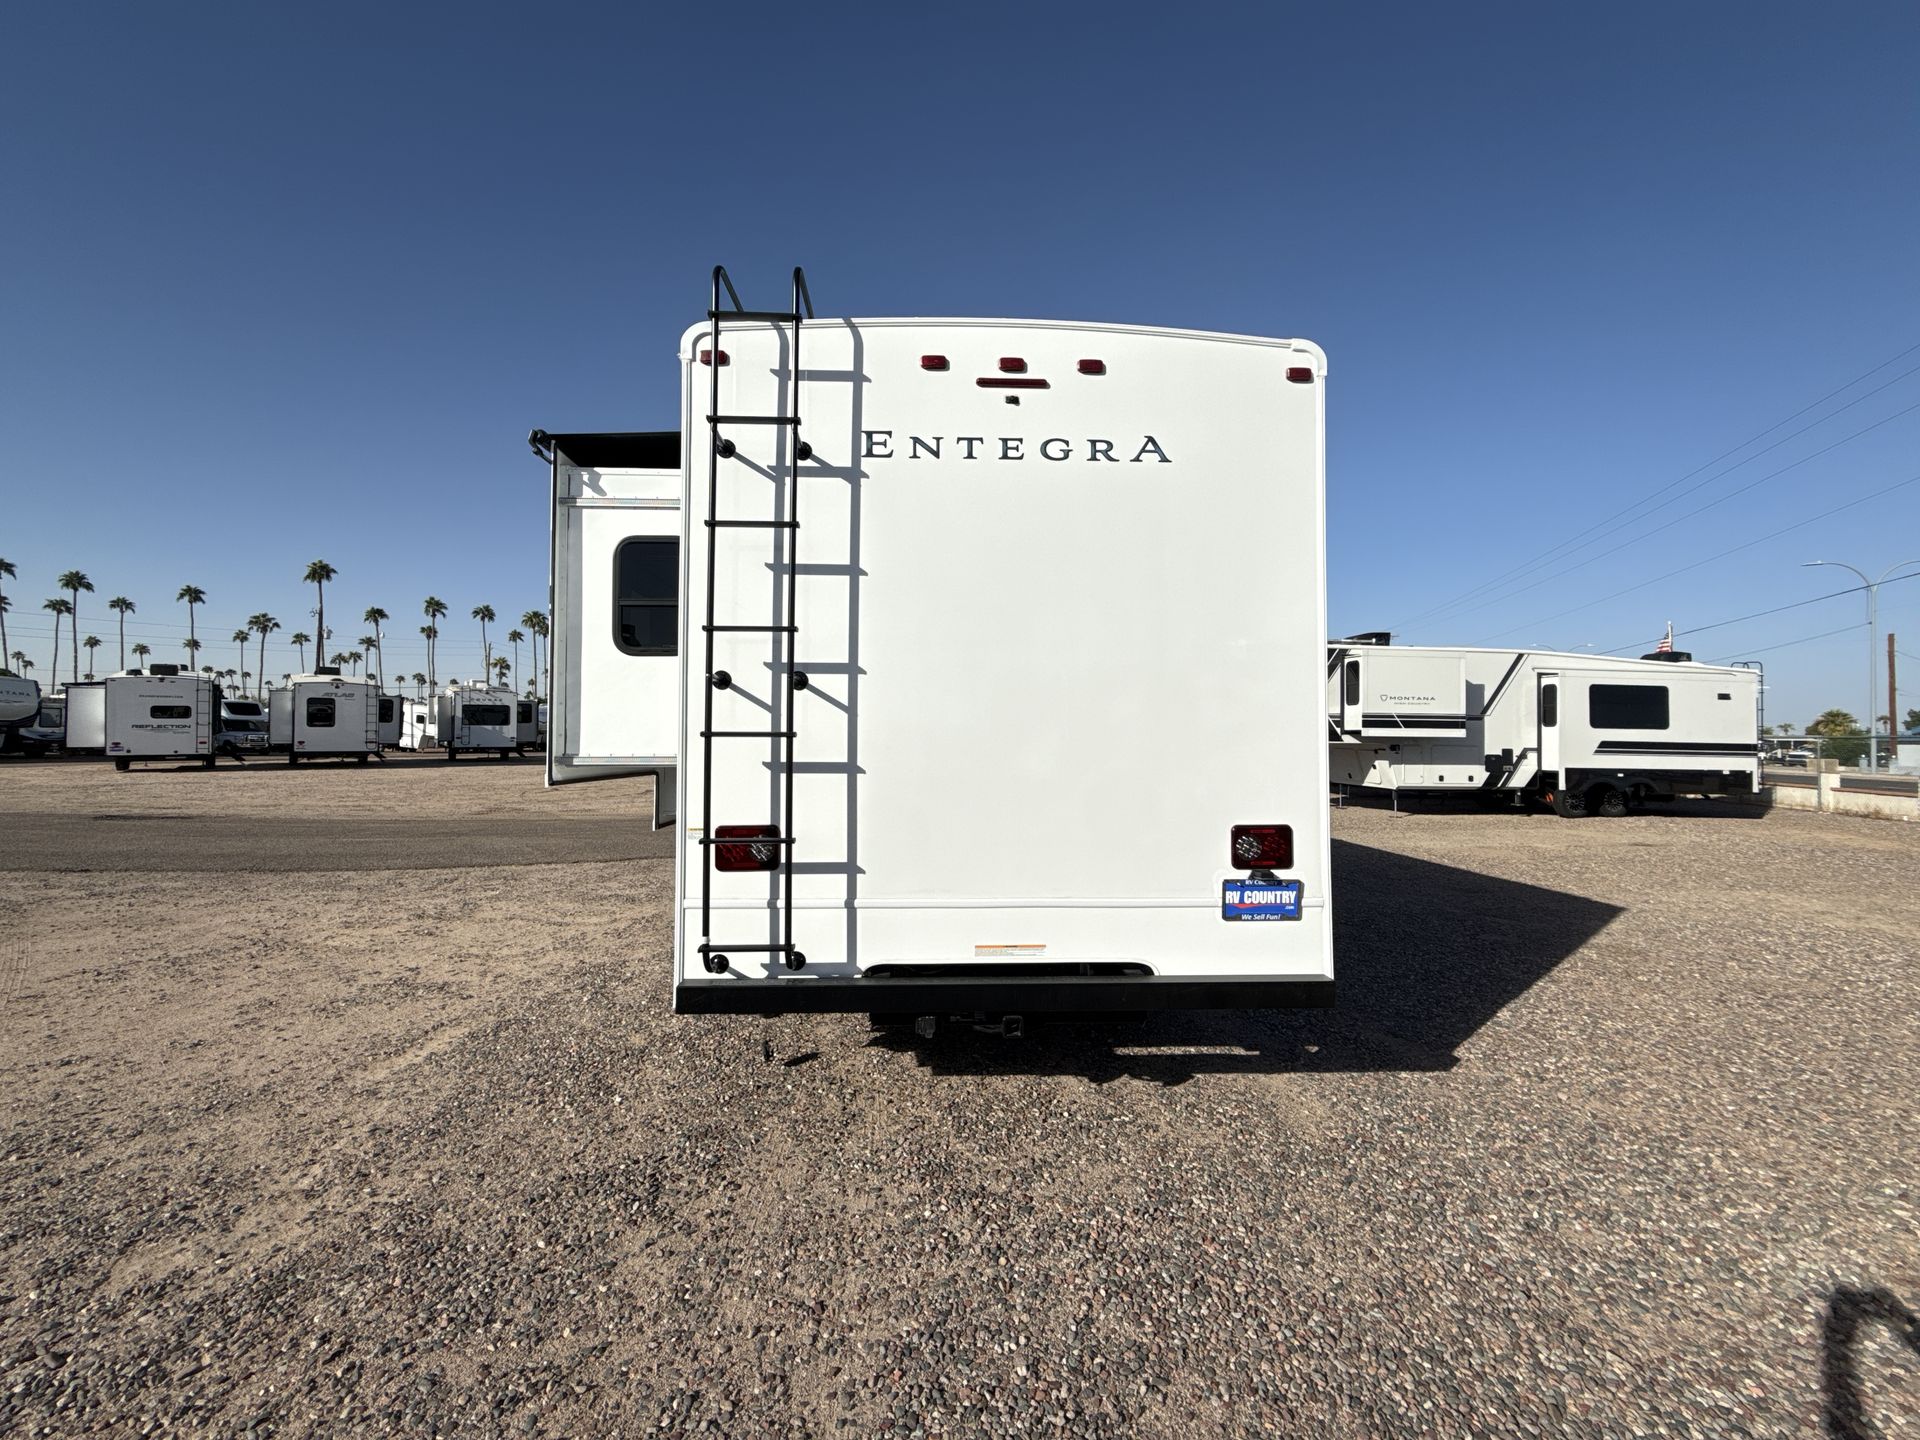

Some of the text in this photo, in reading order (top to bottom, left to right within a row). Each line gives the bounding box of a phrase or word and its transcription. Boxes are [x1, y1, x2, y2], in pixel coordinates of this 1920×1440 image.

[861, 430, 1173, 463] ENTEGRA
[1225, 890, 1297, 904] RV COUNTRY
